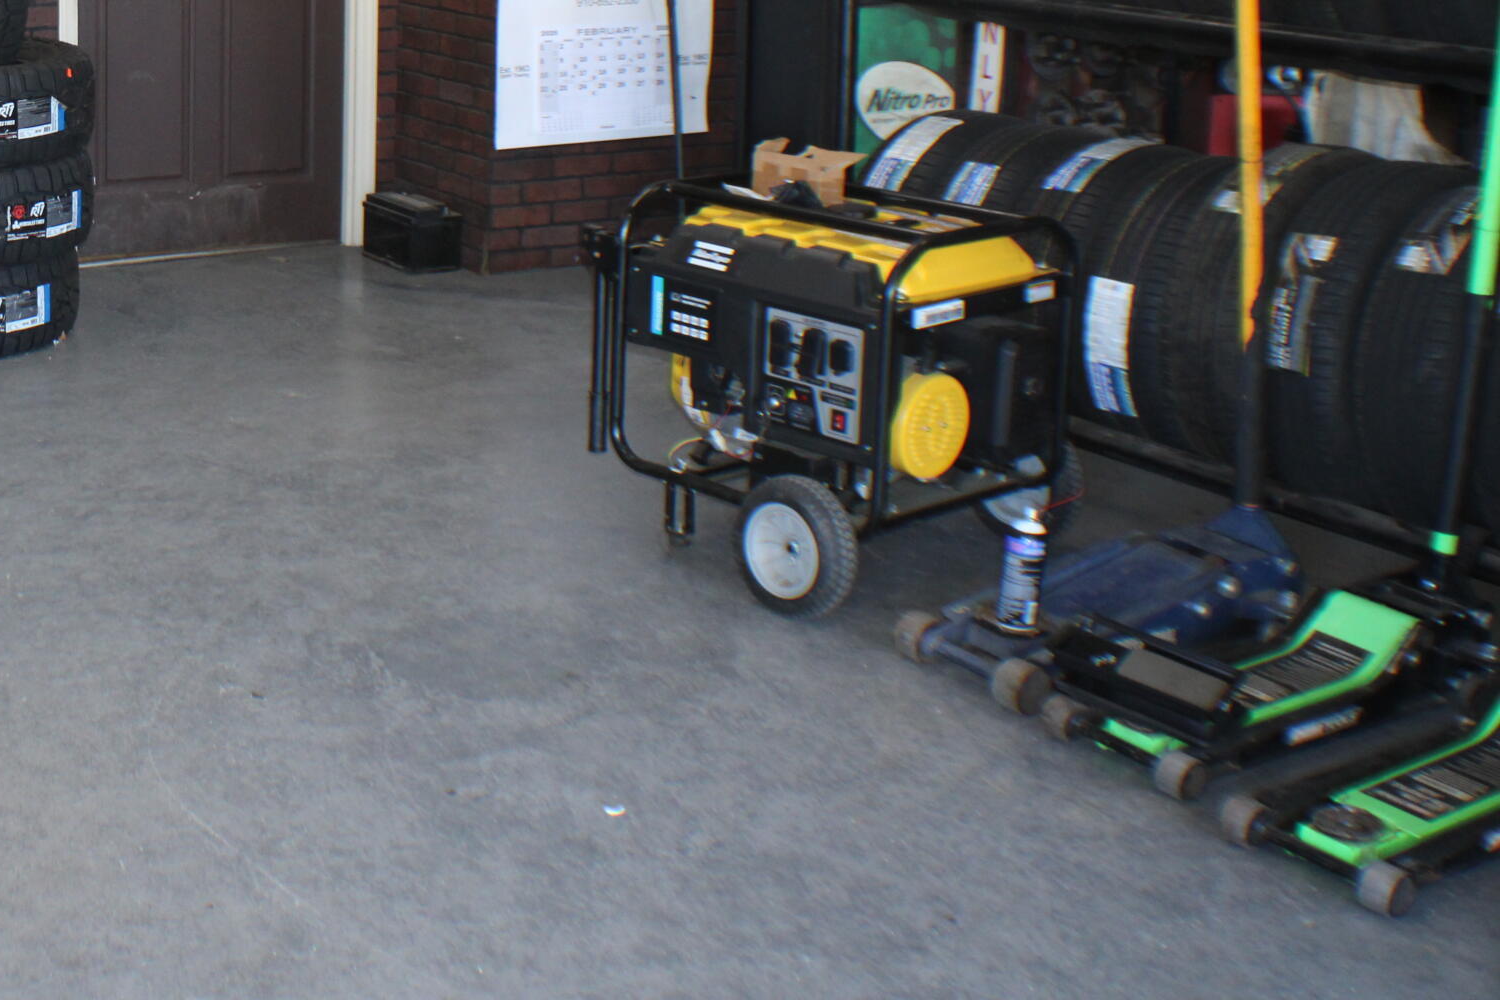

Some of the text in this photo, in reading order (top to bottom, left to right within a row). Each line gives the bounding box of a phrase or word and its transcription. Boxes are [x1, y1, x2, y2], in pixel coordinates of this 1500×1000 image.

[577, 26, 638, 36] FEBRUARY
[866, 88, 950, 112] Nitro Pro
